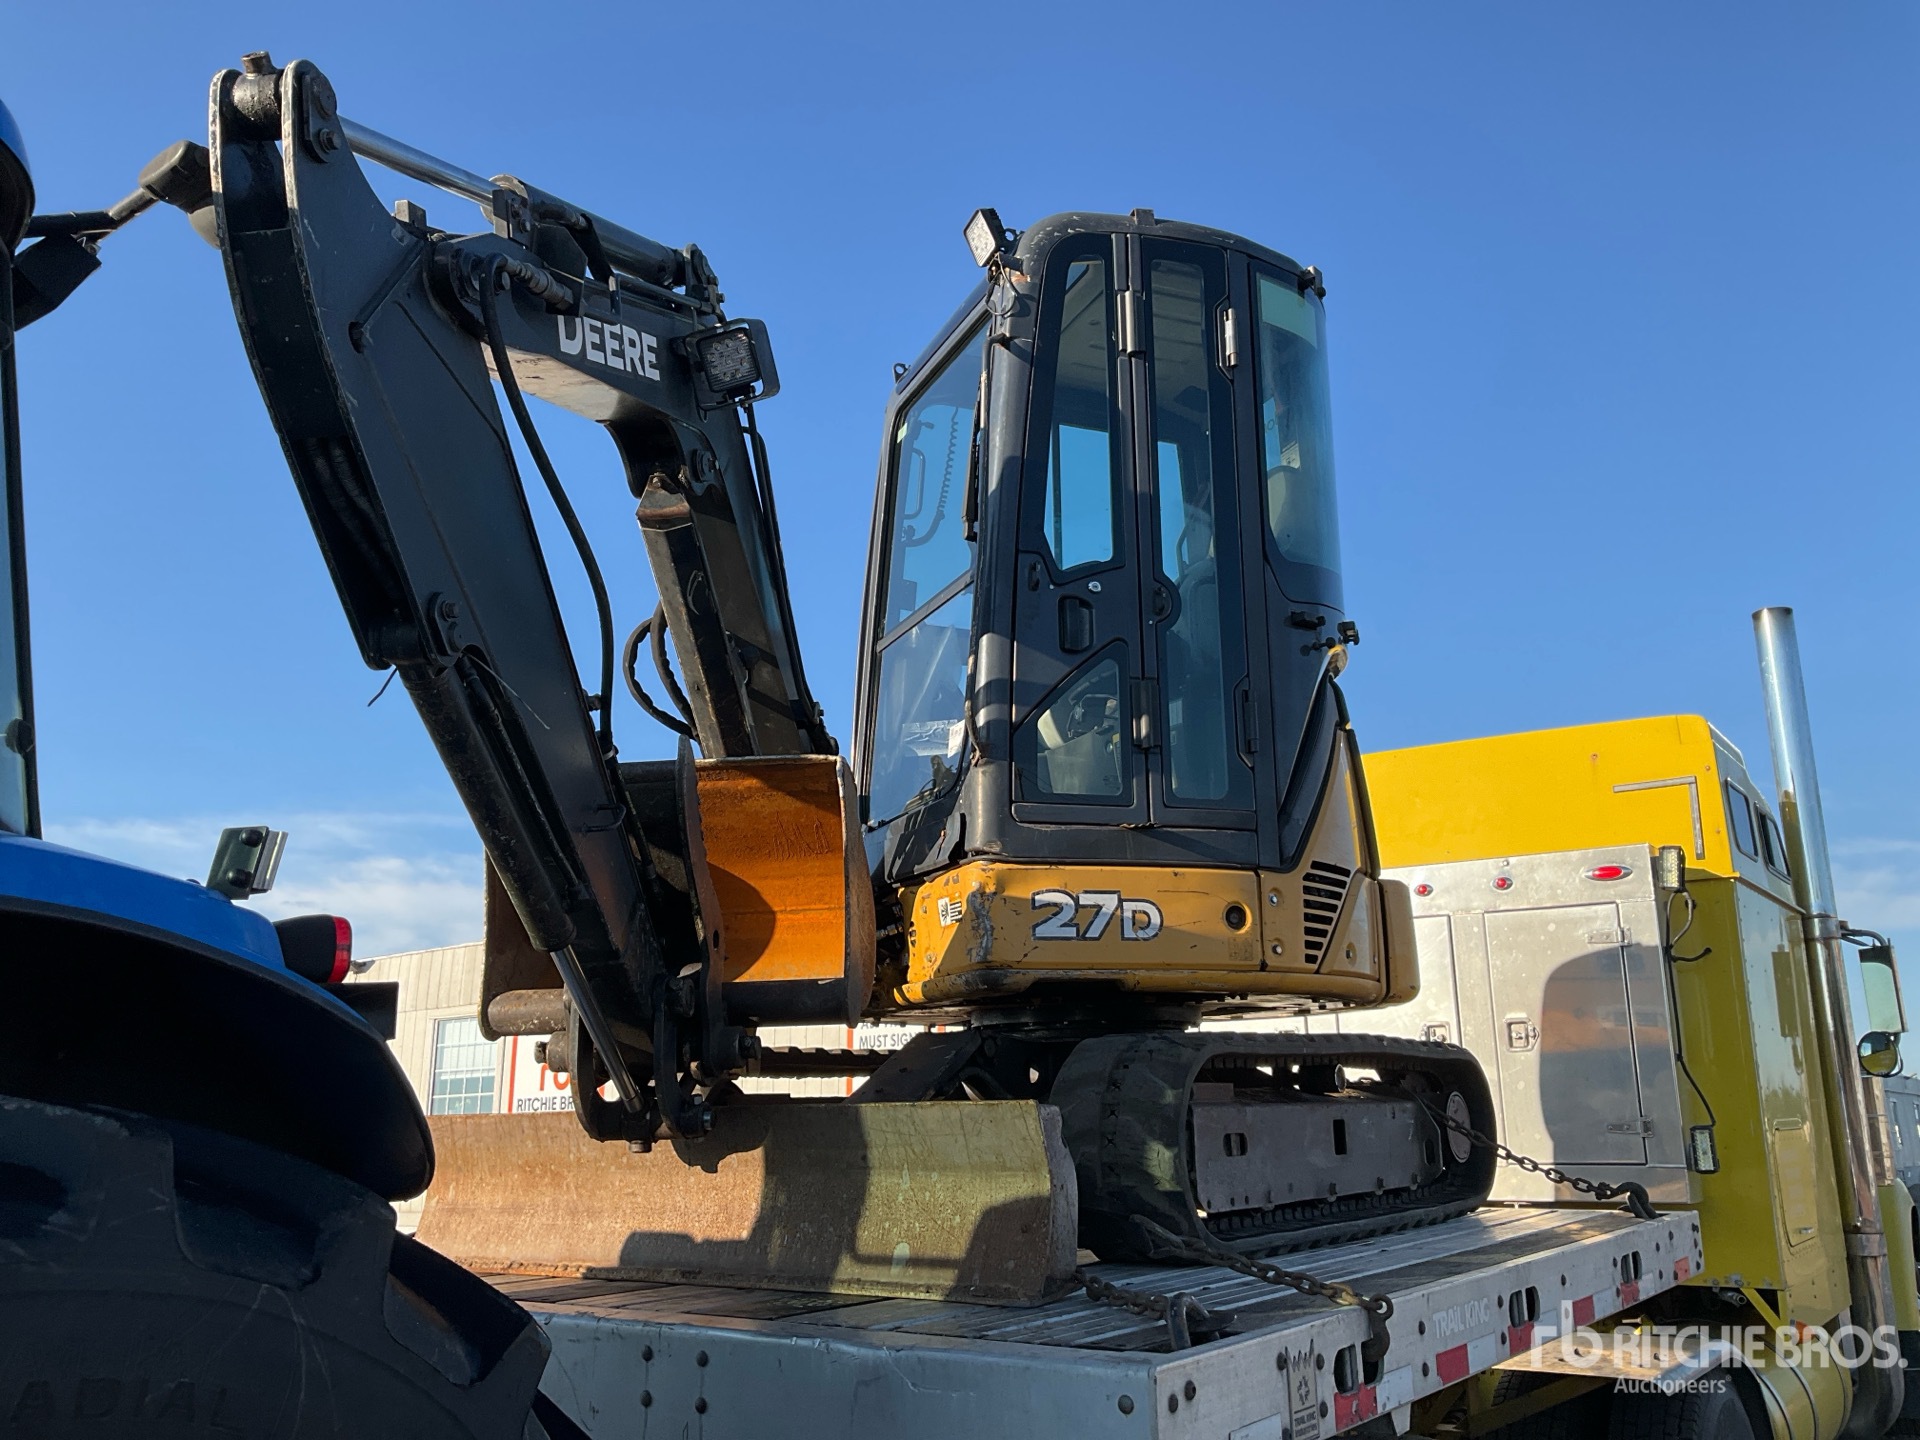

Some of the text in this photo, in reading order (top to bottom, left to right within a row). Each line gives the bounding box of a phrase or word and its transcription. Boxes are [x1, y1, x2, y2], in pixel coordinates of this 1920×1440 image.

[557, 315, 661, 381] DEERE
[1031, 888, 1164, 941] 27D
[859, 1034, 888, 1050] MUST
[516, 1096, 557, 1112] RITCHIE
